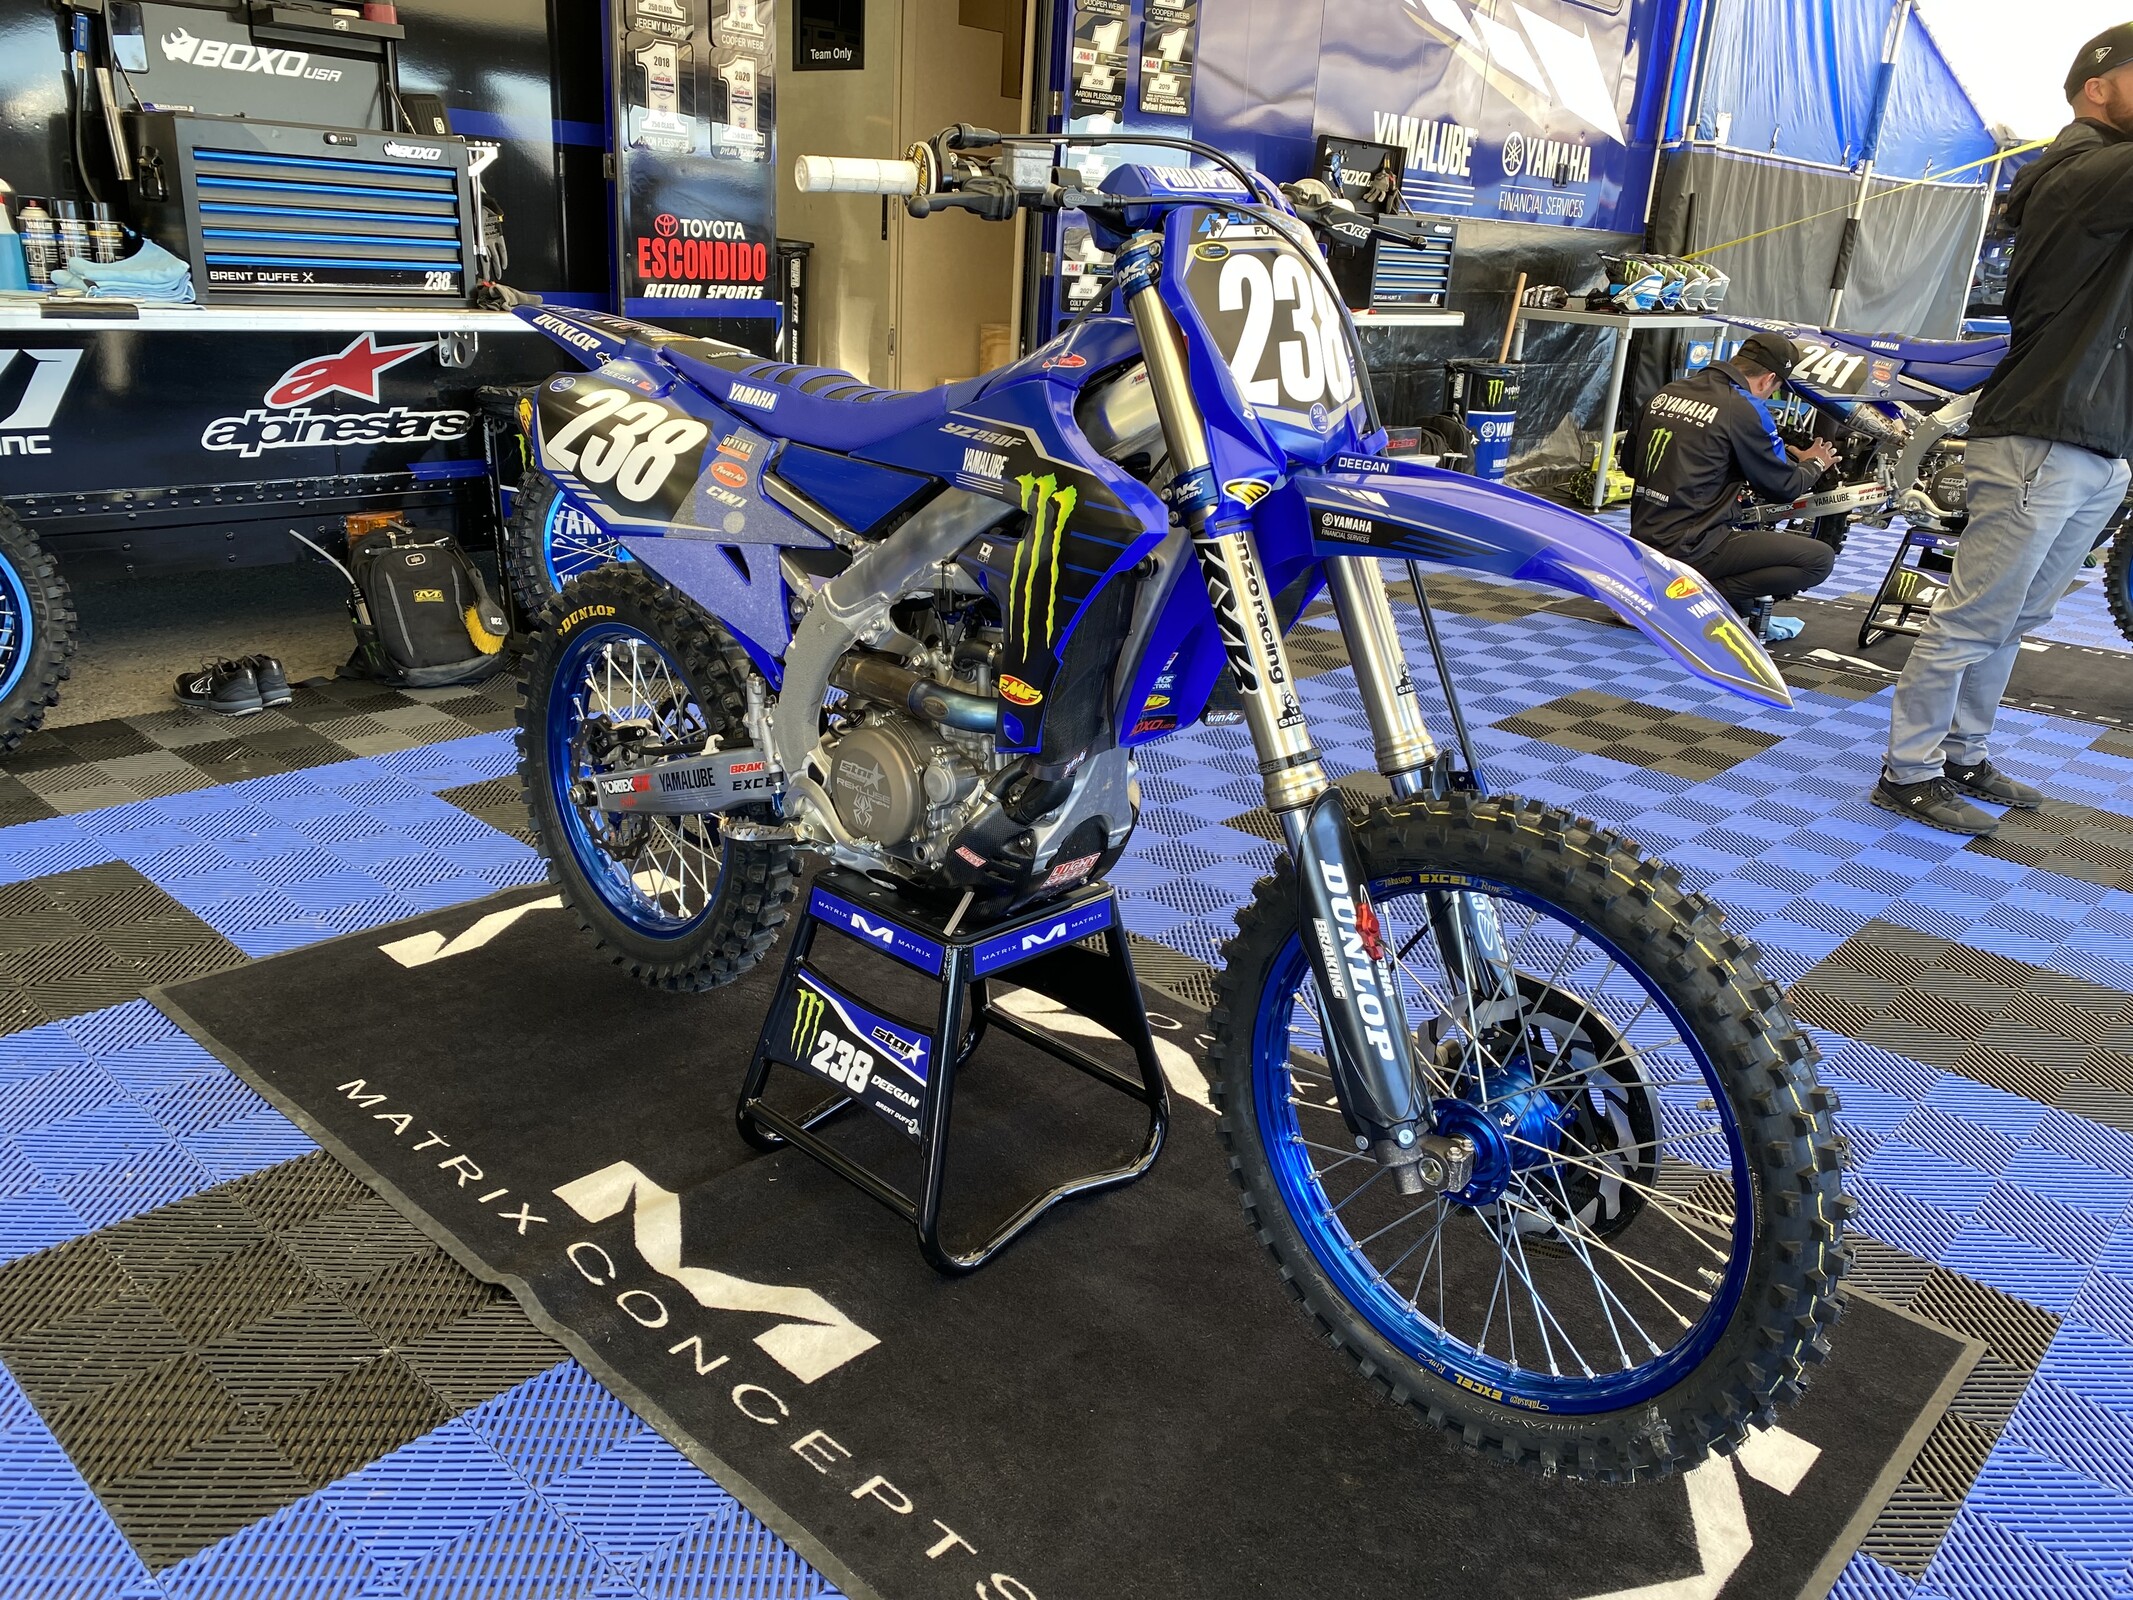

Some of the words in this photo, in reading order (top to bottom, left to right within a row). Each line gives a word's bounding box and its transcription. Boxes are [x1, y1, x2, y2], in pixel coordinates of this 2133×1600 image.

[635, 17, 661, 31] JEREMY
[1151, 7, 1174, 17] COOPER
[1174, 11, 1191, 20] WEBB
[721, 34, 747, 47] COOPER
[747, 38, 764, 50] WEBB
[198, 40, 308, 76] BOXO
[304, 66, 342, 82] USA
[653, 56, 671, 68] 2018
[810, 48, 832, 60] Team
[833, 48, 853, 62] Only
[1075, 90, 1093, 99] AARON
[1093, 92, 1122, 102] PLESSINGER
[1158, 83, 1171, 91] 2019
[397, 145, 442, 160] BOXO
[1374, 111, 1474, 177] YAMALUBE
[1526, 138, 1592, 183] YAMAHA
[1498, 191, 1545, 215] FINANCIAL
[1546, 194, 1585, 218] SERVICES
[680, 218, 746, 240] TOYOTA
[1332, 222, 1371, 240] ARC
[637, 237, 767, 281] ESCONDIDO
[209, 270, 254, 283] BRENT
[257, 271, 299, 283] DUFFE
[424, 271, 452, 292] 238
[643, 283, 702, 299] ACTION
[705, 284, 764, 300] SPORTS
[532, 313, 602, 352] DUNLOP
[1219, 252, 1353, 407] 238
[1727, 315, 1785, 332] DUNLOP
[1870, 339, 1900, 351] YAMAHA
[601, 368, 639, 385] DEEGAN
[1790, 345, 1865, 390] 241
[729, 382, 777, 410] YAMAHA
[1649, 409, 1705, 428] RACING
[1662, 395, 1719, 424] YAMAHA
[202, 407, 470, 457] alpinestars
[546, 388, 708, 502] 238
[722, 437, 755, 454] OPTIMA
[716, 465, 735, 478] Twin
[962, 447, 1010, 480] YAMALUBE
[1338, 456, 1390, 473] DEEGAN
[1814, 493, 1850, 507] YAMALUBE
[1321, 528, 1347, 540] FINANCIAL
[1346, 532, 1371, 544] SERVICES
[1333, 515, 1372, 533] YAMAHA
[1604, 586, 1647, 616] BICYCLES
[1610, 580, 1655, 611] YAMAHA
[561, 604, 616, 633] DUNLOP
[1252, 599, 1286, 686] racing
[999, 678, 1042, 702] FMF
[601, 777, 635, 798] VORTEX
[658, 767, 716, 792] YAMALUBE
[836, 776, 891, 805] REKLUSE
[1419, 873, 1472, 886] EXCEL
[818, 900, 848, 919] MATRIX
[897, 939, 931, 959] MATRIX
[981, 944, 1017, 962] MATRIX
[1071, 912, 1103, 929] MATRIX
[1314, 919, 1348, 999] BRAKING
[1318, 859, 1395, 1061] DUNLOP
[810, 1029, 873, 1094] 238
[871, 1074, 920, 1109] DEEGAN
[875, 1100, 895, 1116] BRENT
[337, 1078, 548, 1236] MATRIX
[1454, 1372, 1504, 1402] EXCEL
[566, 1242, 1038, 1600] CONCEPTS
